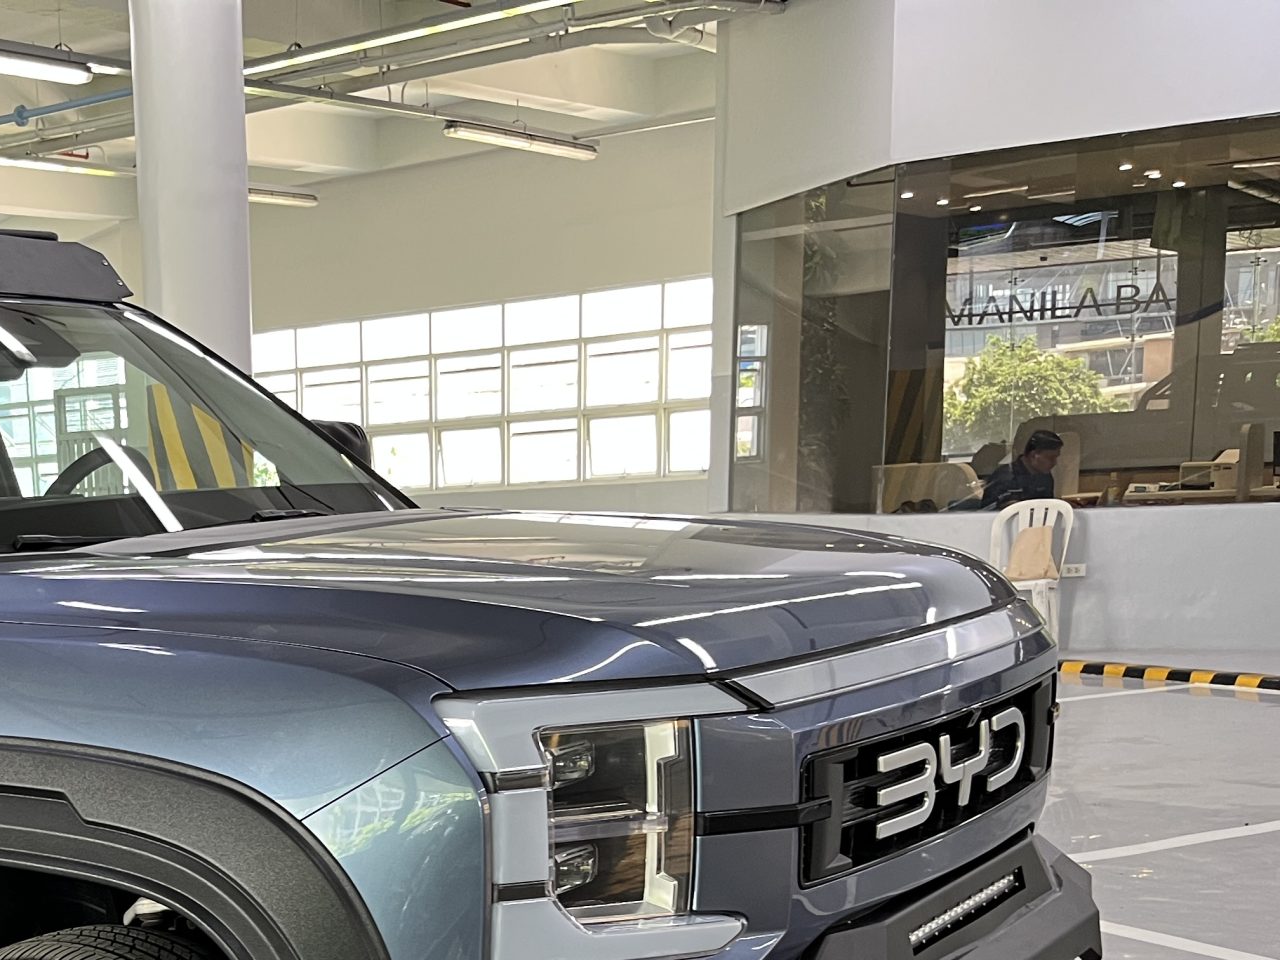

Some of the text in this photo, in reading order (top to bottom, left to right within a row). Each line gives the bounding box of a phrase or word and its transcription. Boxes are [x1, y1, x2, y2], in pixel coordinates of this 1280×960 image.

[946, 281, 1176, 326] MANILA BA
[876, 706, 1026, 839] BYD
